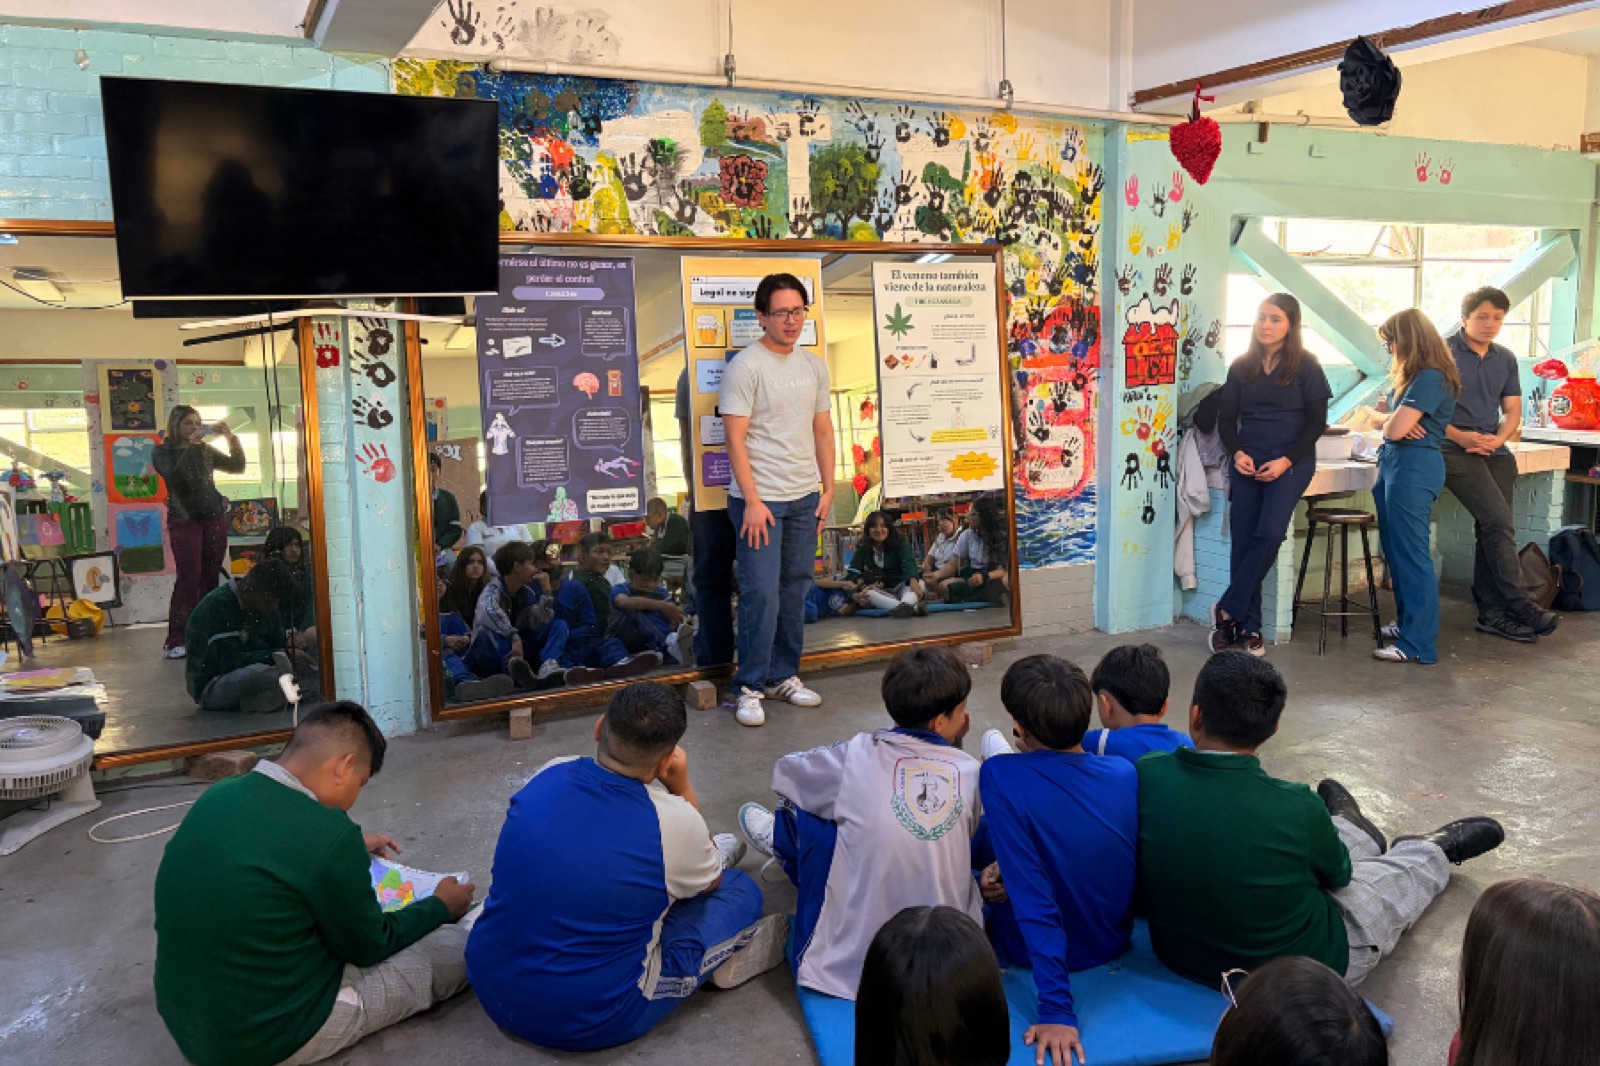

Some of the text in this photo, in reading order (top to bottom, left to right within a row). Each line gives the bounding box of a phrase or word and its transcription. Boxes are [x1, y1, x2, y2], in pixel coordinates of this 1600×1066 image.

[567, 260, 579, 270] no
[565, 274, 595, 284] control
[891, 269, 979, 280] El veneno también
[883, 281, 987, 292] viene de la naturaleza
[699, 287, 724, 299] Legal
